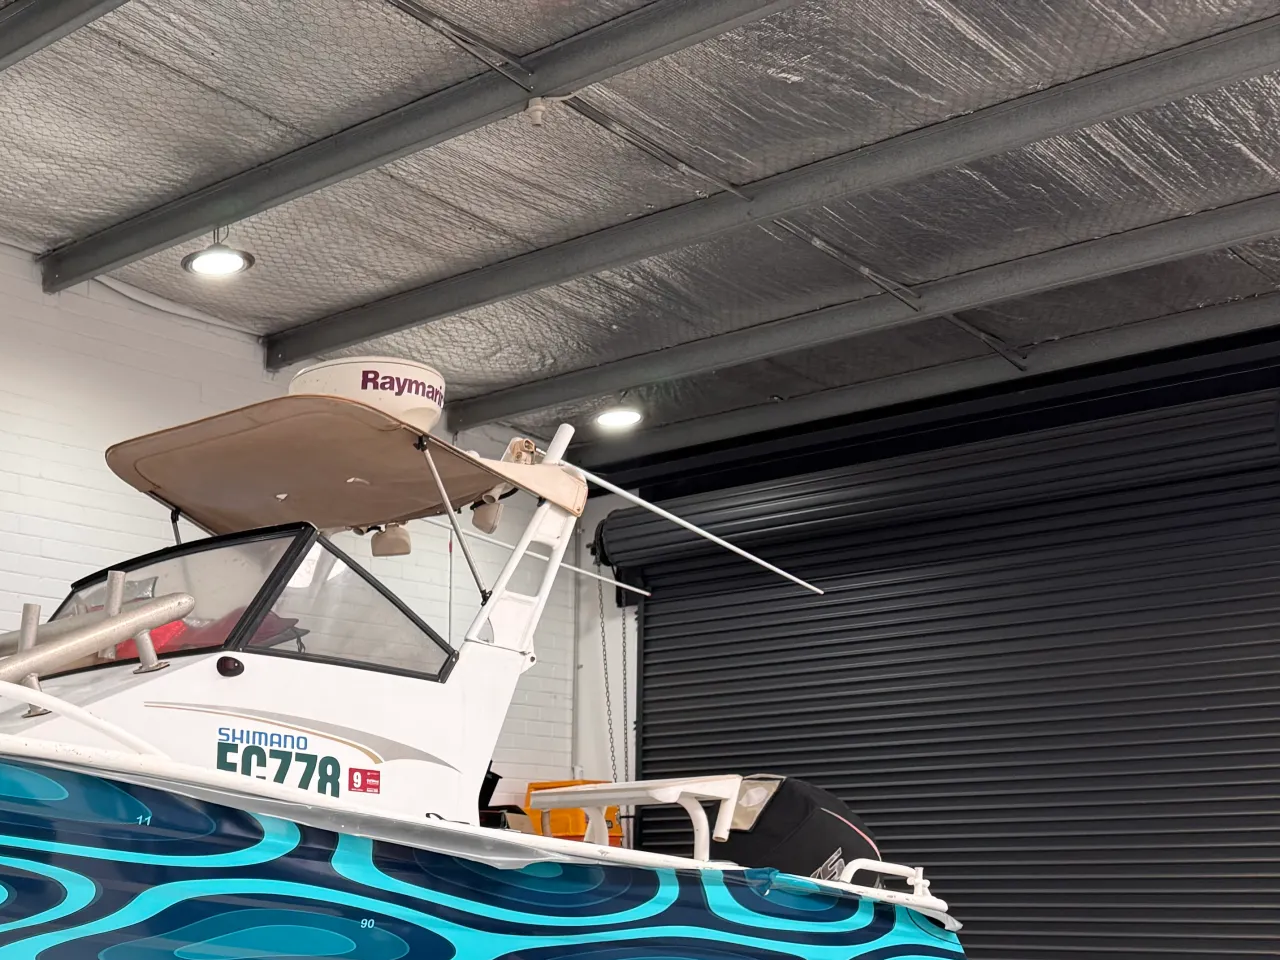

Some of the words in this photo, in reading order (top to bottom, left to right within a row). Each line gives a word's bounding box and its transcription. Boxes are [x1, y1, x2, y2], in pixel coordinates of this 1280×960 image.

[218, 727, 308, 750] SHIMANO
[353, 771, 362, 788] 9
[136, 814, 151, 826] 11
[360, 918, 375, 929] 90
